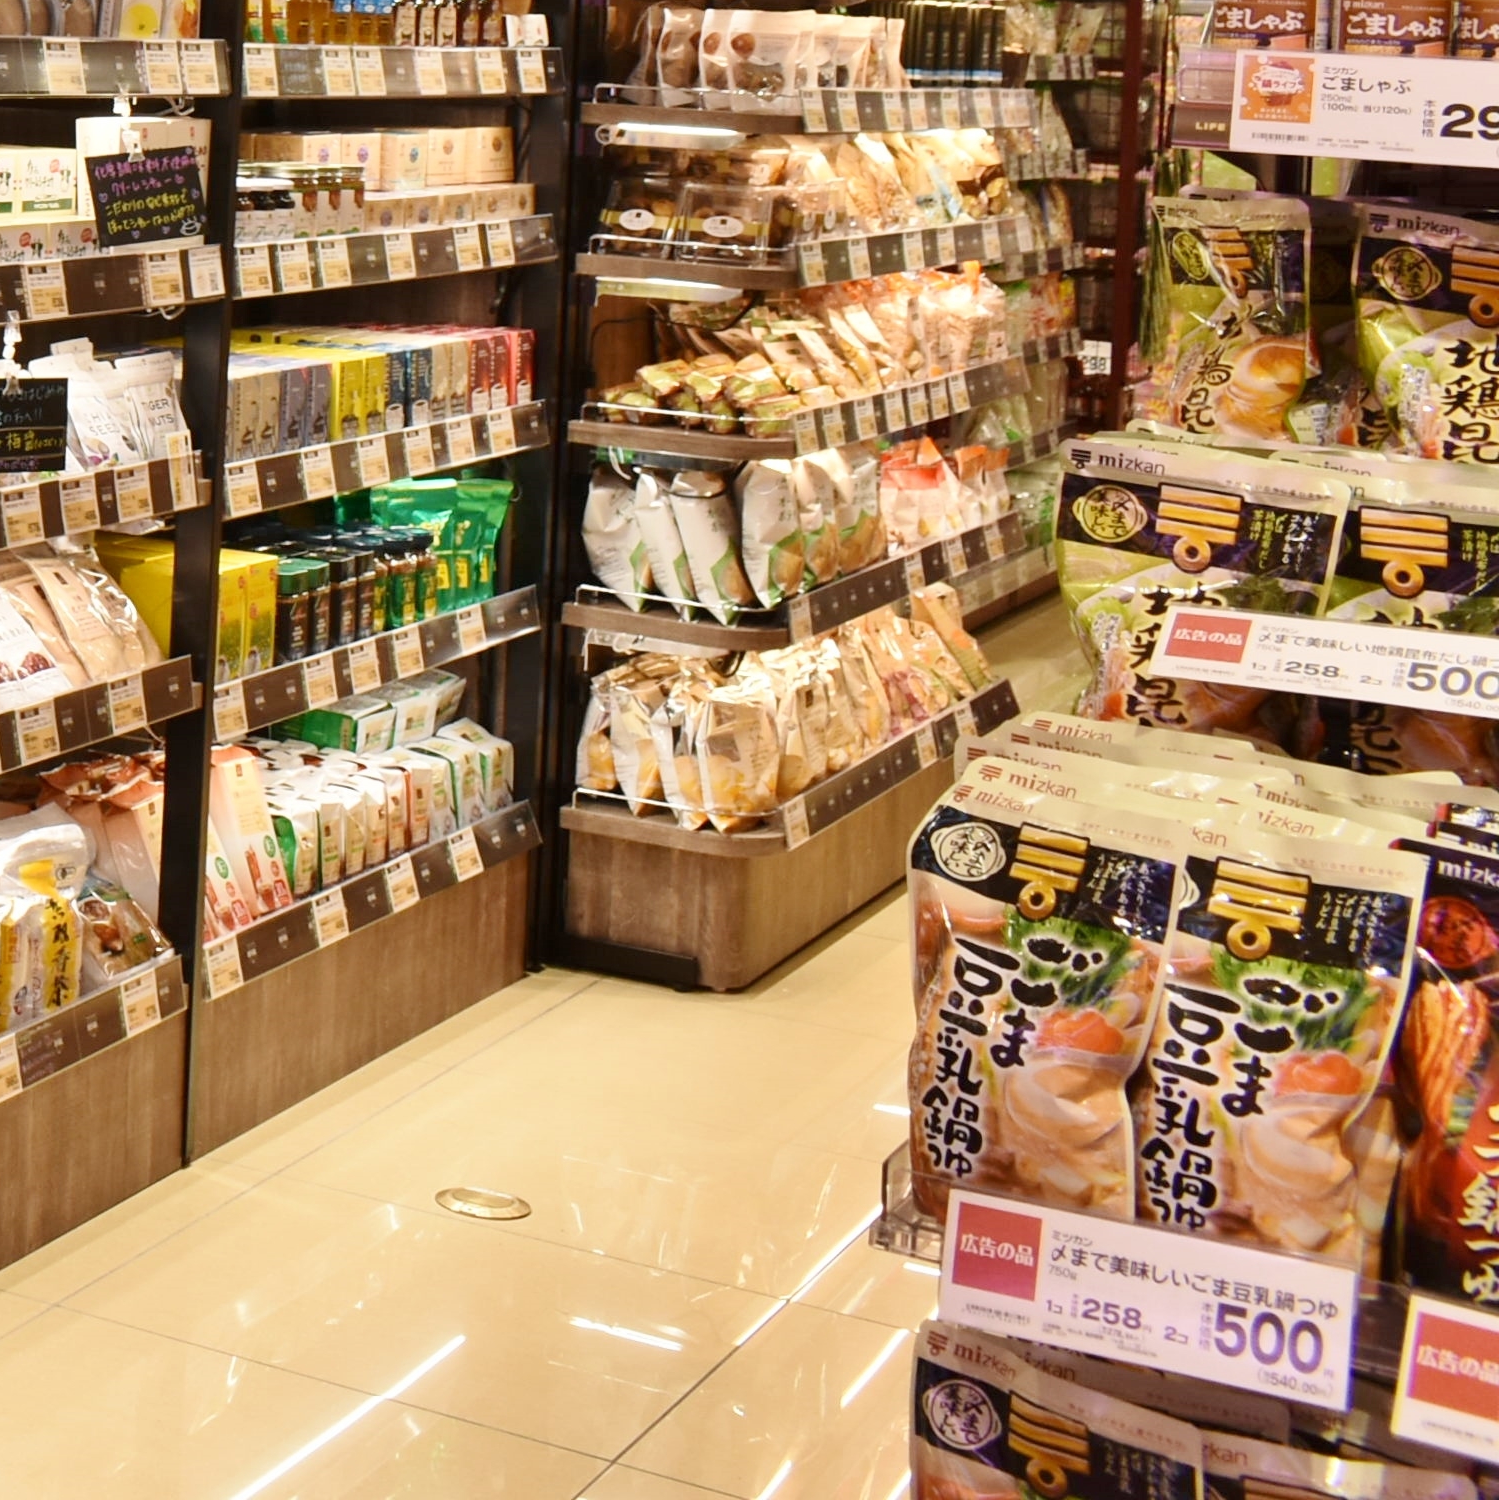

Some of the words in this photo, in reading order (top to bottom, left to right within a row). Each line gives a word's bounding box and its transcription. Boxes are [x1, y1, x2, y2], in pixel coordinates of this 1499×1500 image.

[1346, 11, 1446, 38] ごましゃぶ
[1321, 75, 1412, 94] ごましゃぶ
[1195, 121, 1226, 132] LIFE
[1396, 212, 1461, 237] mizkan
[1098, 451, 1165, 476] mizkan
[1173, 627, 1244, 647] 広告の品
[1008, 771, 1078, 800] mizkan
[959, 1232, 1035, 1269] 広告の品
